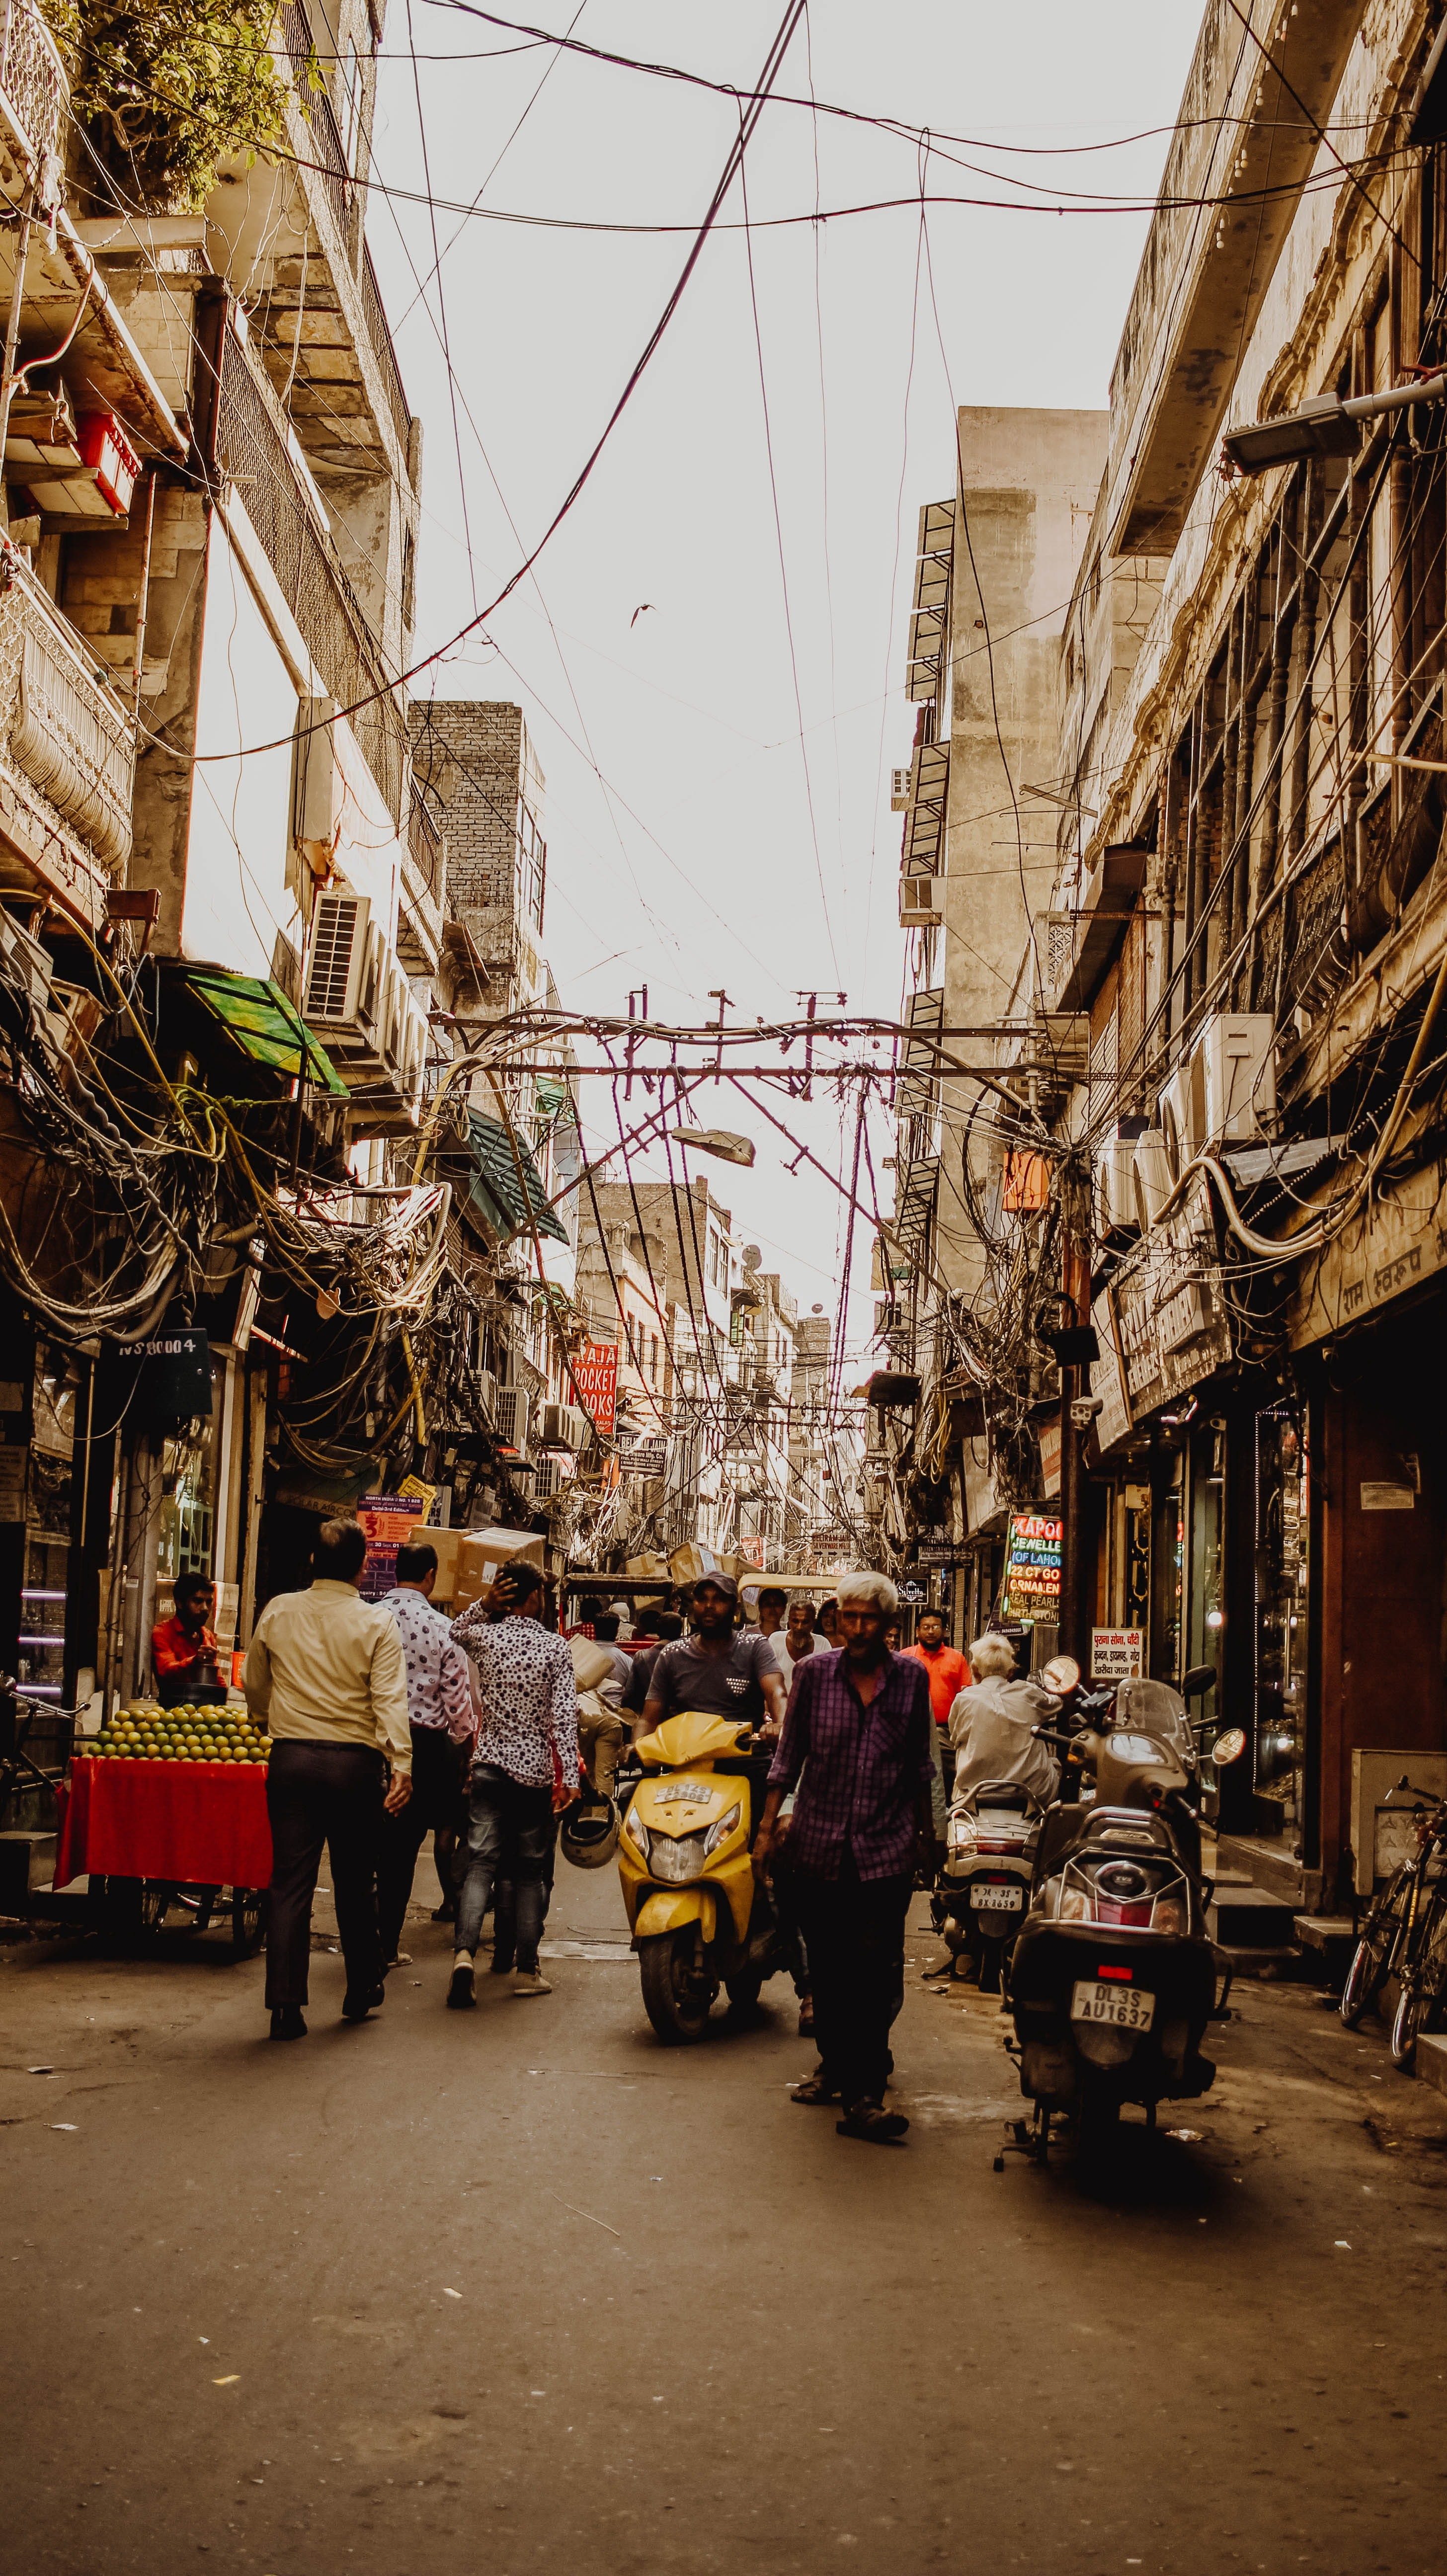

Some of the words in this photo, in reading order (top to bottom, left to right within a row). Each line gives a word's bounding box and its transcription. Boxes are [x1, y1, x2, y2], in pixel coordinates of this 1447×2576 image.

[576, 1342, 615, 1366] RAJA
[574, 1367, 615, 1391] POCKET
[1011, 1565, 1023, 1576] 22
[1025, 1566, 1042, 1578] CT
[1009, 1593, 1029, 1605] REAL
[1094, 1635, 1109, 1647] पुराना
[1082, 2001, 1150, 2027] AU1637
